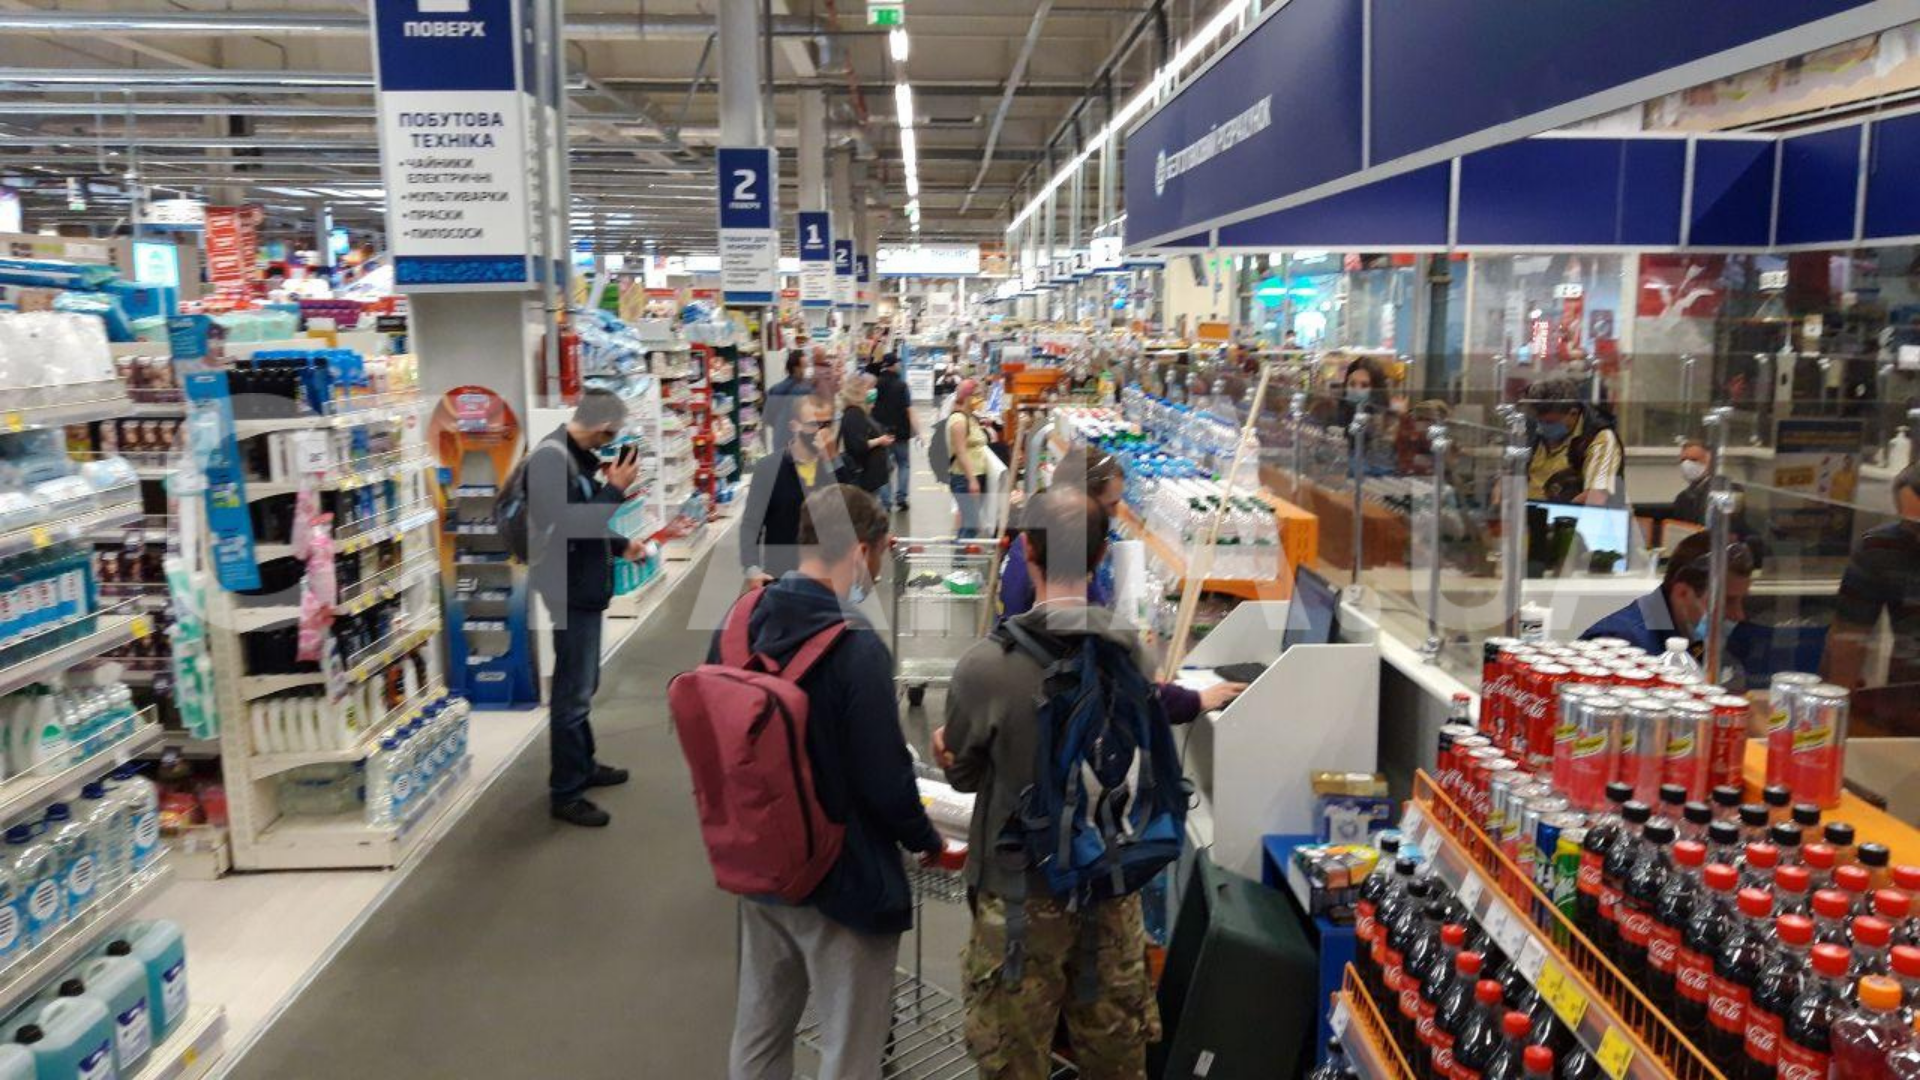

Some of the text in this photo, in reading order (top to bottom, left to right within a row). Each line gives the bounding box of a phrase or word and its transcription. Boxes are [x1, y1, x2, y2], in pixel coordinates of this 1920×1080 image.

[404, 21, 486, 37] ПОВЕРХ
[399, 112, 504, 127] ПОБУТОВА
[411, 133, 496, 147] ТЕХНІКА
[407, 156, 474, 168] ЧАЙНИКИ
[407, 173, 493, 183] ЕЛЕКТРИЧНІ
[733, 169, 757, 200] 2
[408, 191, 510, 202] МУЛЬТИВАРКИ
[410, 210, 464, 220] ПРАСКИ
[411, 228, 484, 239] ПИЛОСОСИ
[806, 224, 822, 243] 1
[837, 249, 848, 263] 2
